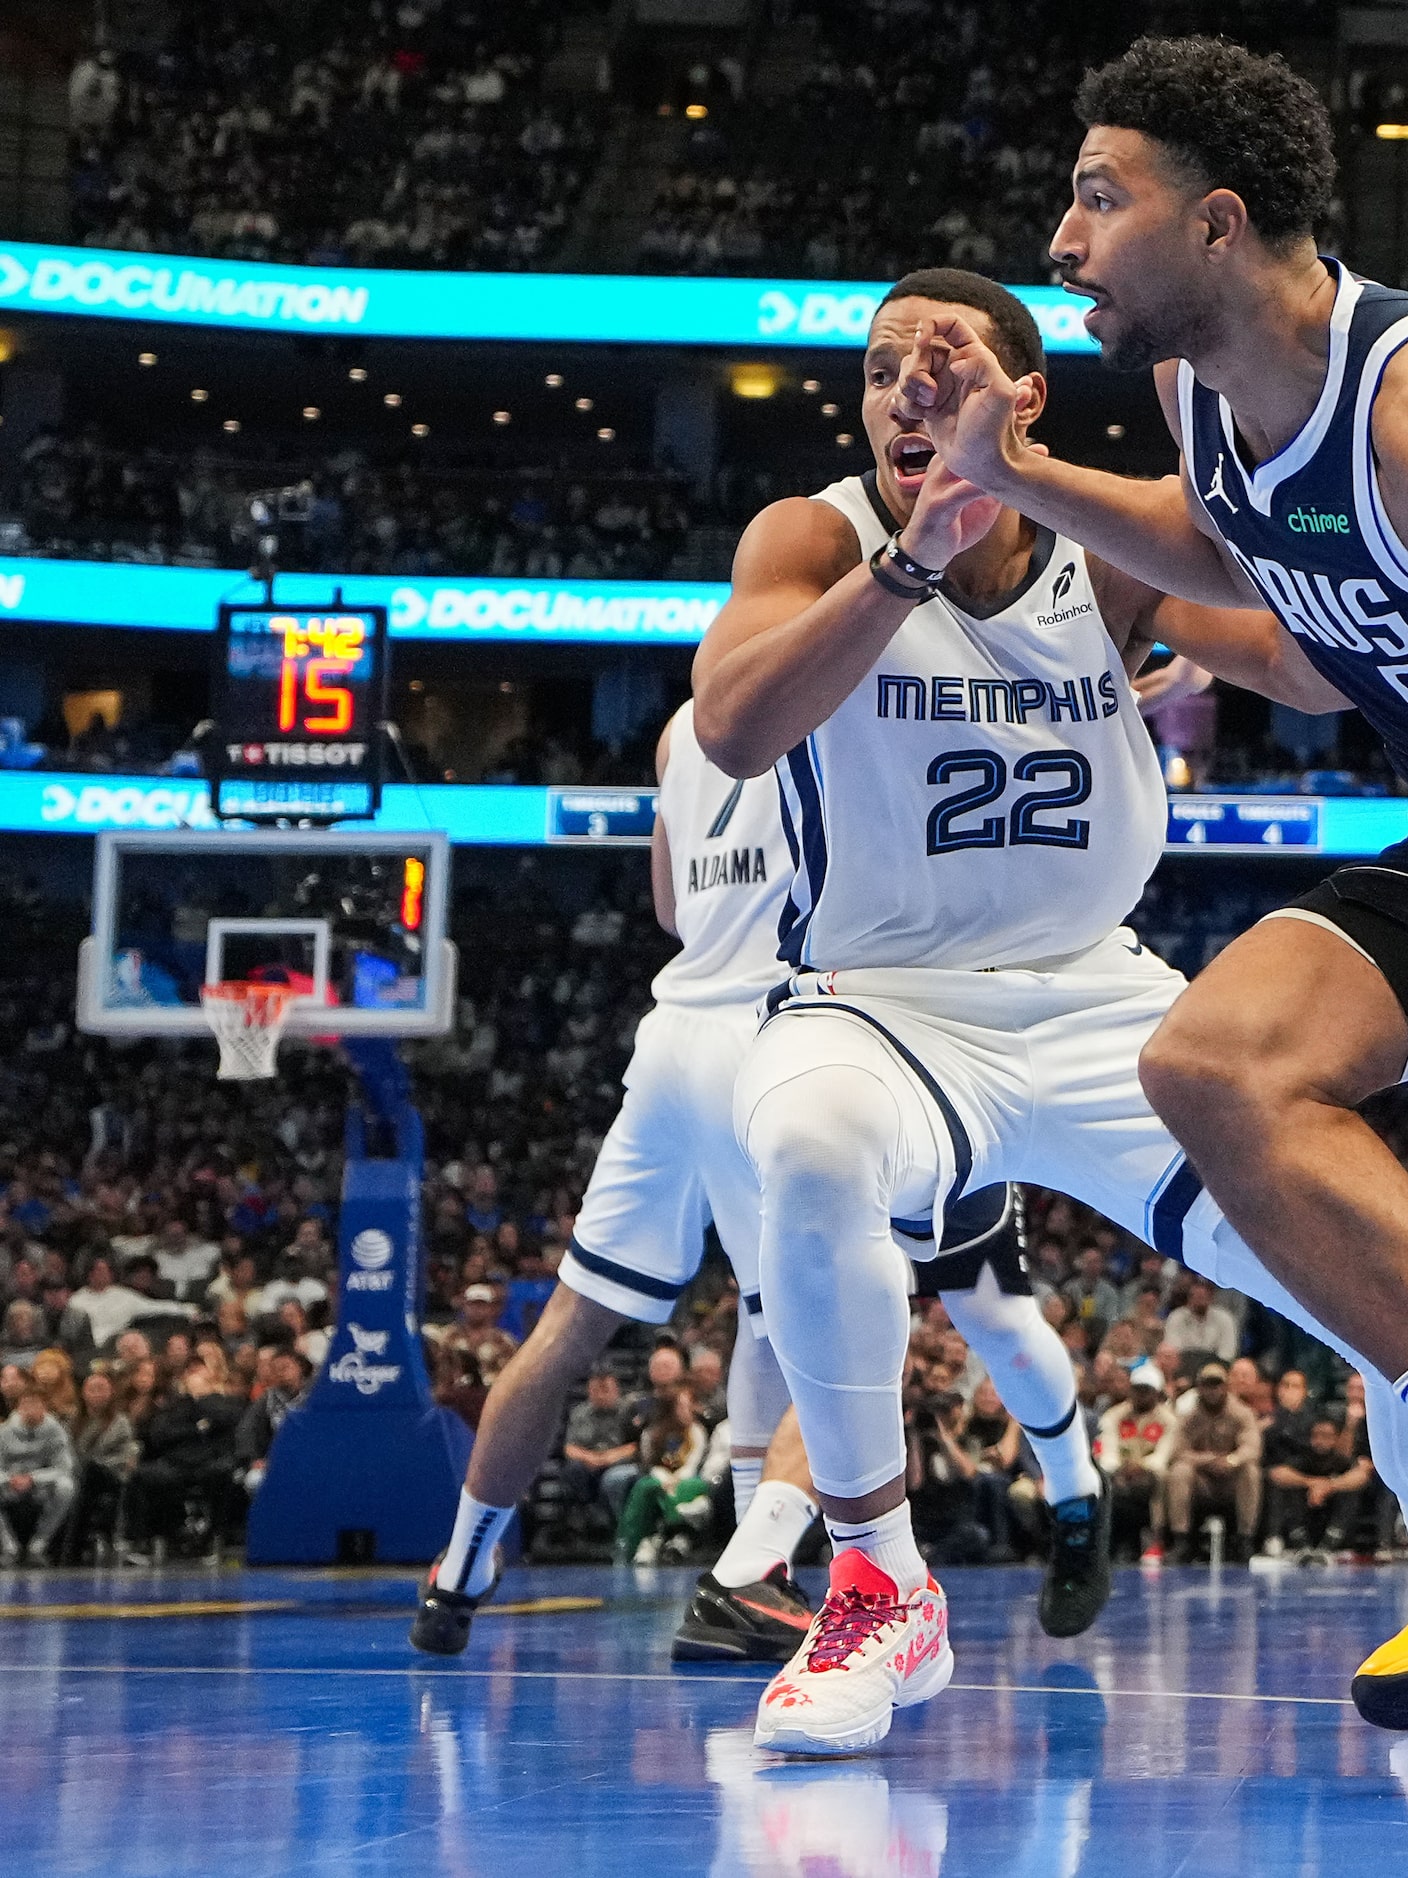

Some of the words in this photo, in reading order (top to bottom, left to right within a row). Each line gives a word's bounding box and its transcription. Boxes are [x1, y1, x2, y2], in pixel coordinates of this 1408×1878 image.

[1288, 506, 1351, 534] chime
[269, 616, 364, 661] 7:42
[279, 658, 354, 735] 15
[877, 670, 1119, 725] MEMPHIS
[926, 749, 1092, 857] 22
[687, 847, 767, 895] ALDAMA
